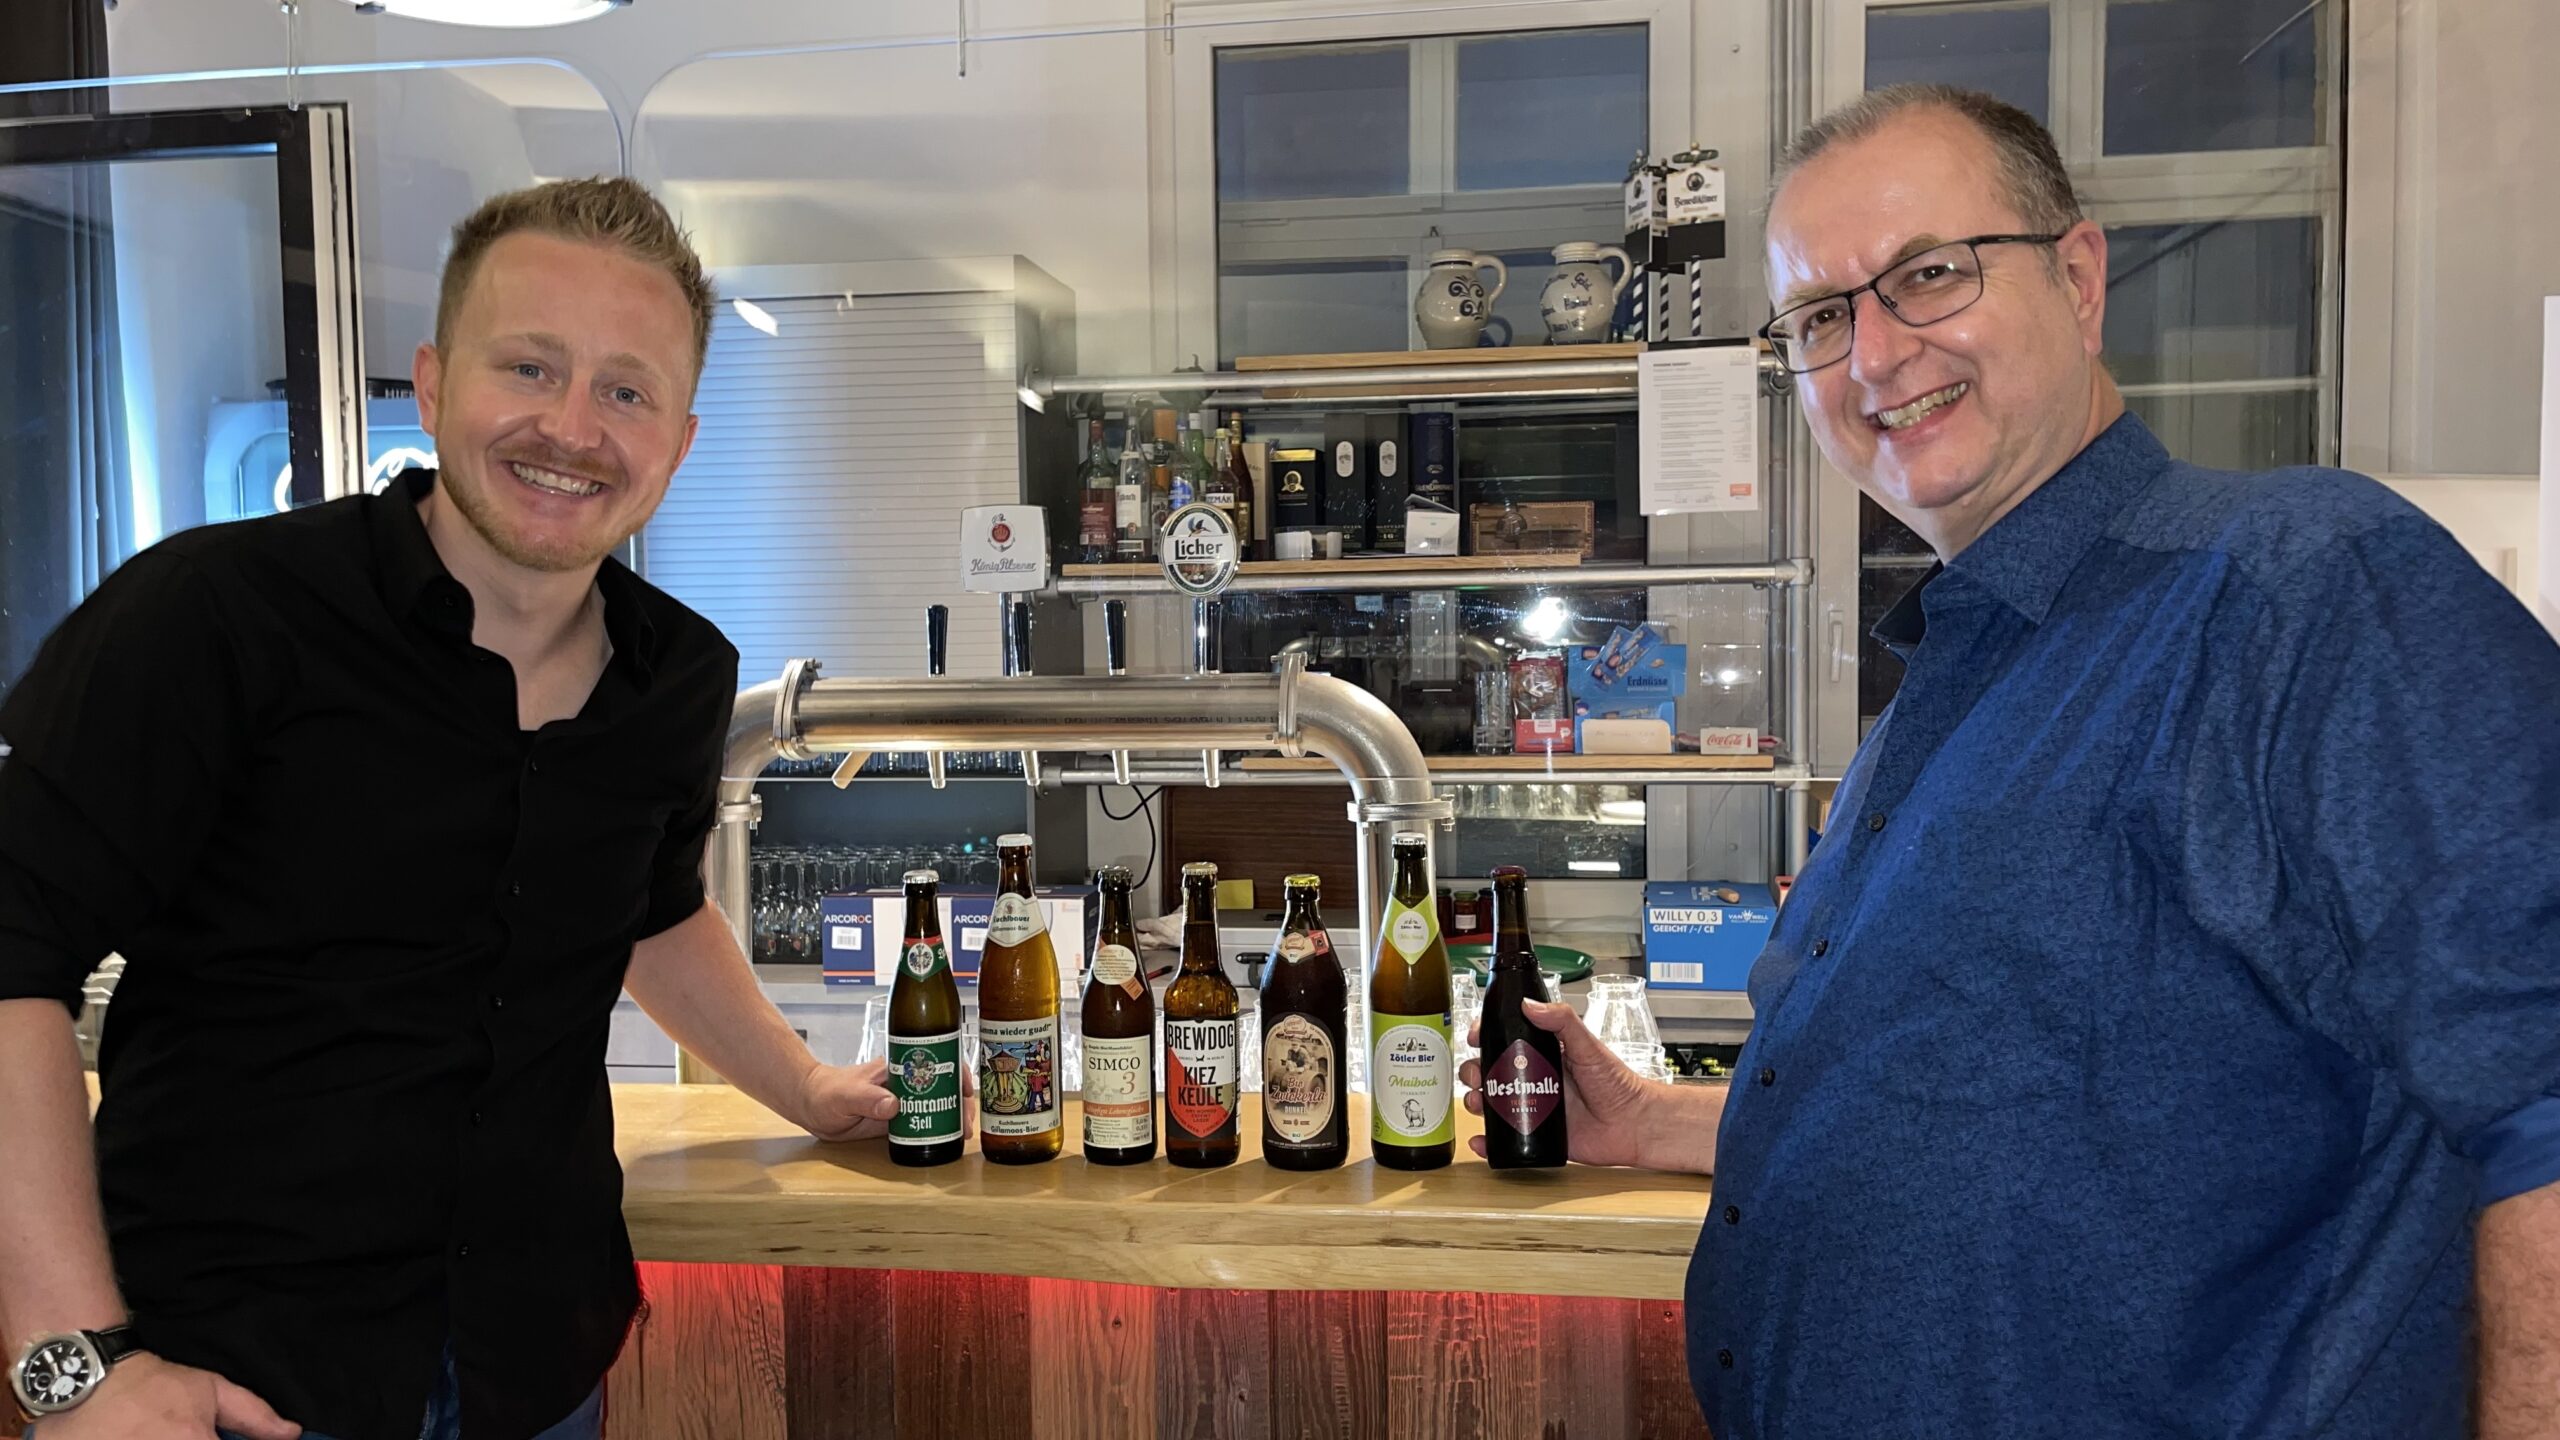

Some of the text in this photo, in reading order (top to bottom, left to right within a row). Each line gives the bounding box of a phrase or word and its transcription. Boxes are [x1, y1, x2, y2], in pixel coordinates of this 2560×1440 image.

[1175, 539, 1223, 560] Licher
[1627, 676, 1668, 687] Erdnüsse
[824, 914, 872, 924] ARCOROC
[953, 914, 992, 924] ARCOR
[1653, 910, 1719, 923] WILLY 0,3
[1652, 925, 1688, 933] GEEICHT
[1704, 925, 1715, 933] CE
[1000, 1026, 1027, 1036] wieder
[1167, 1024, 1234, 1050] BREWDOG
[1088, 1056, 1141, 1071] SIMCO
[1390, 1053, 1436, 1062] Zötler Bier
[1119, 1071, 1136, 1095] 3
[1184, 1066, 1217, 1086] KIEZ
[1388, 1074, 1439, 1087] Maibock
[1486, 1076, 1560, 1097] Westmalle
[1178, 1086, 1224, 1106] KEULE
[900, 1094, 957, 1116] hönramer
[908, 1116, 932, 1132] Hell
